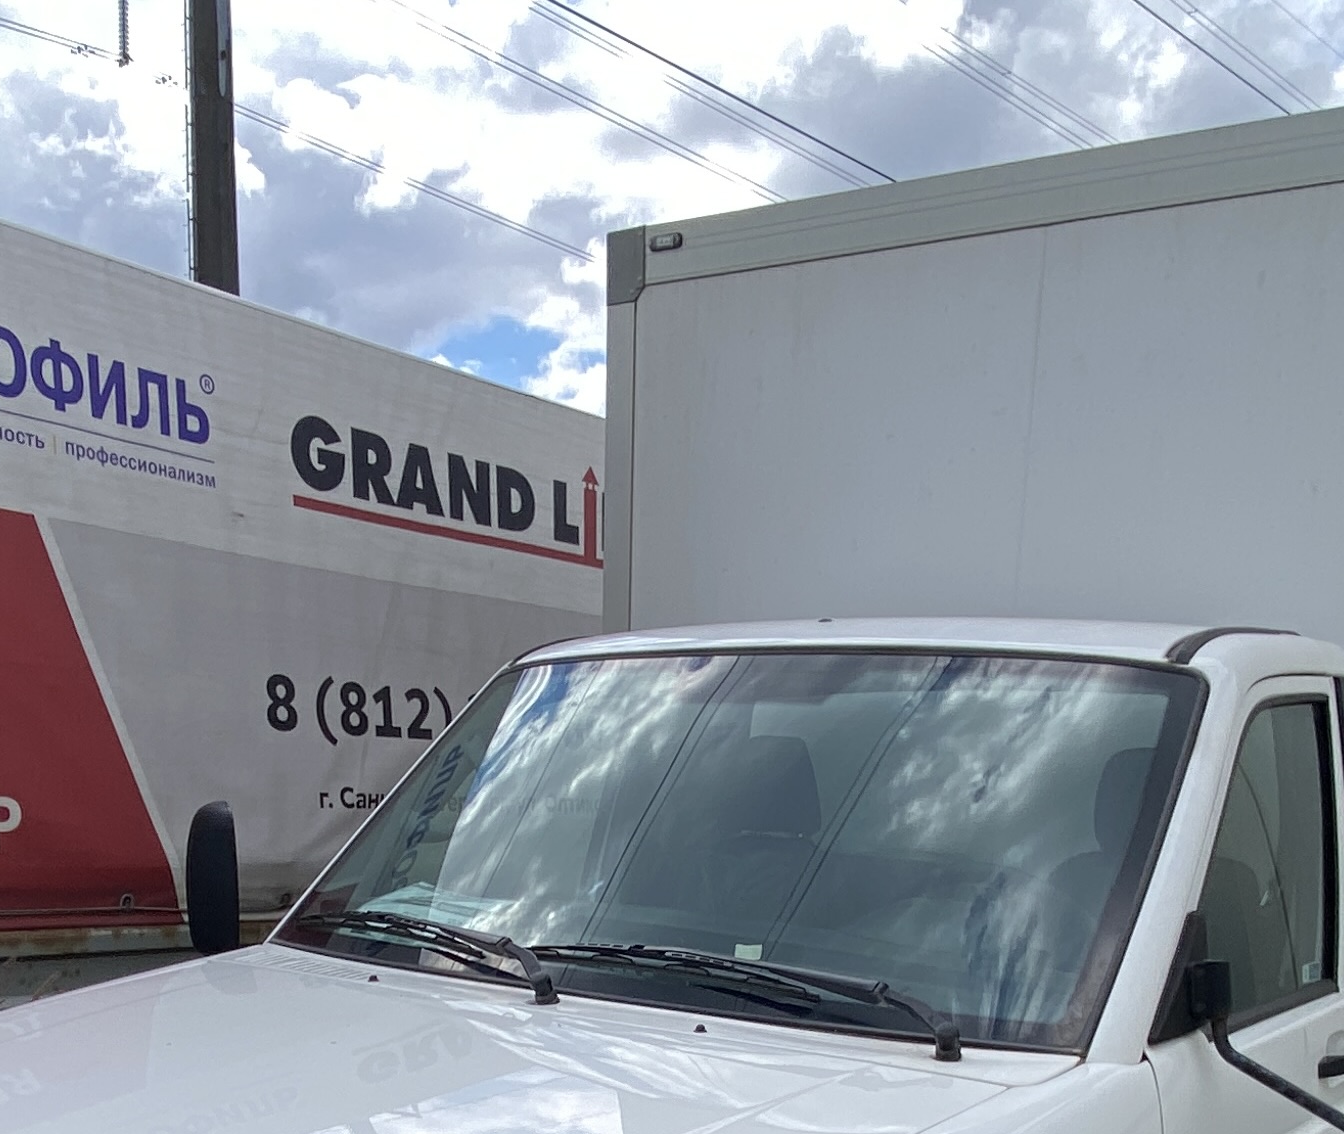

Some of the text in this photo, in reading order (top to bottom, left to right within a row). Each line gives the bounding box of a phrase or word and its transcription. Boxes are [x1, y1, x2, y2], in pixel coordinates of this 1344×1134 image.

[64, 440, 217, 489] профессионализм
[291, 415, 536, 532] GRAND
[266, 673, 453, 747] 8 (812)
[319, 791, 334, 809] г.
